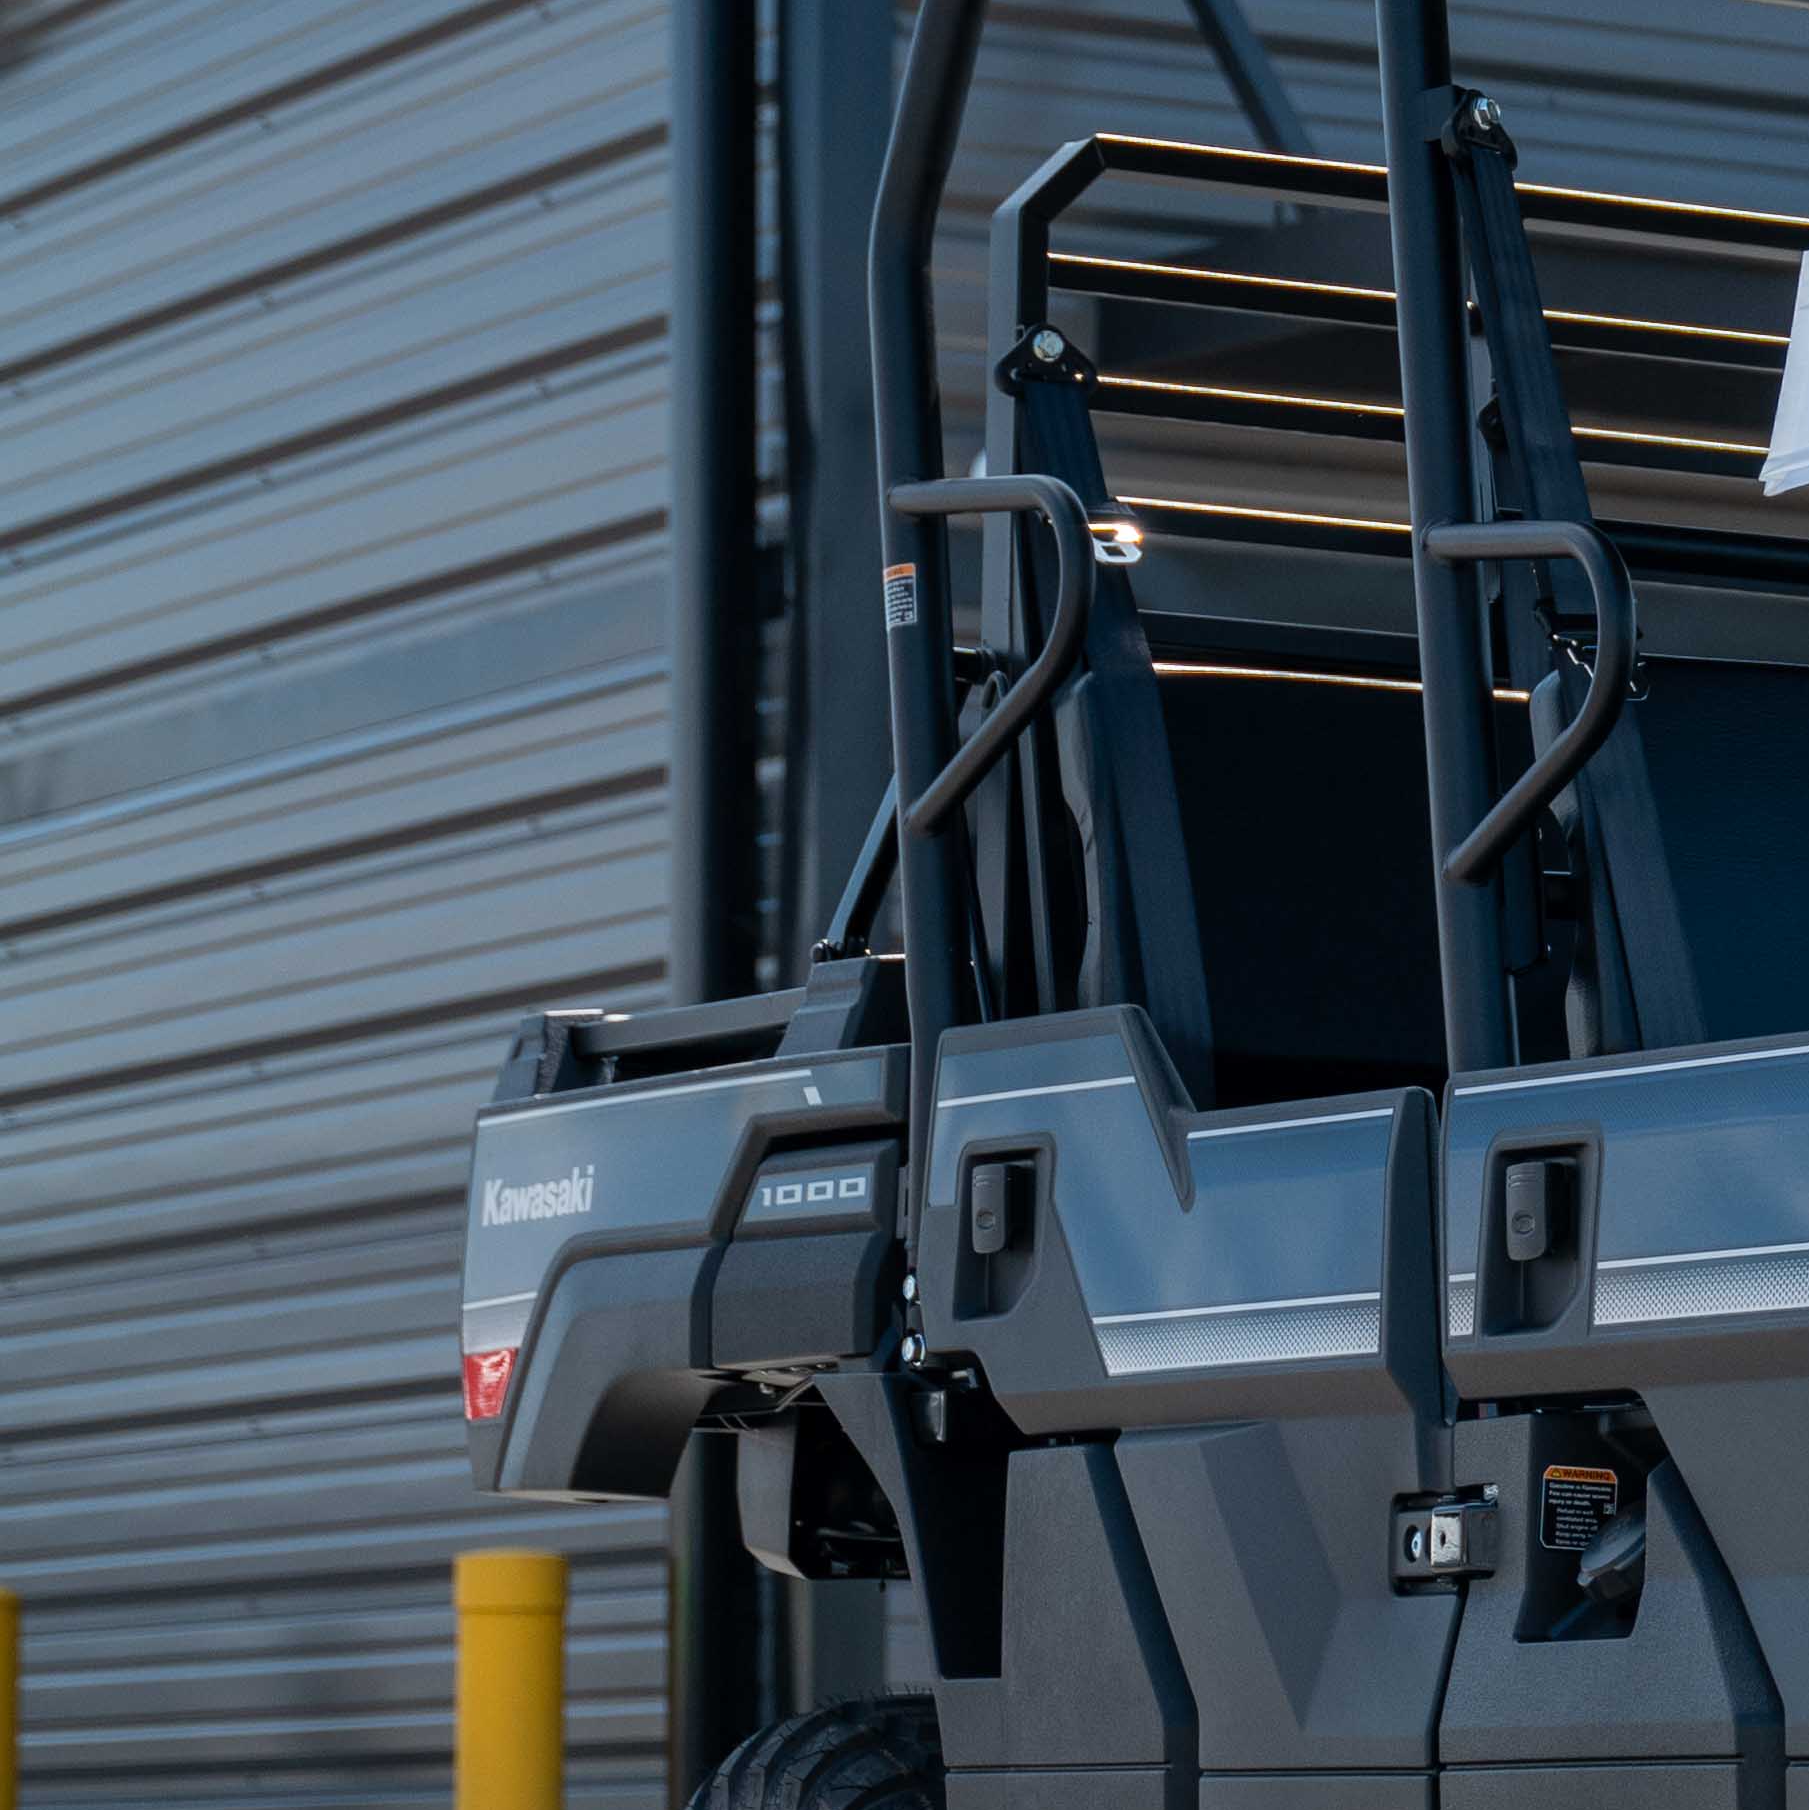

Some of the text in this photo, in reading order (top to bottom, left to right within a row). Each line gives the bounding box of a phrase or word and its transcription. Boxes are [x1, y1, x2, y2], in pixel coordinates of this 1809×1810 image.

[481, 1163, 596, 1228] Kawasaki
[762, 1175, 867, 1208] 1000
[1563, 1469, 1610, 1481] WARNING
